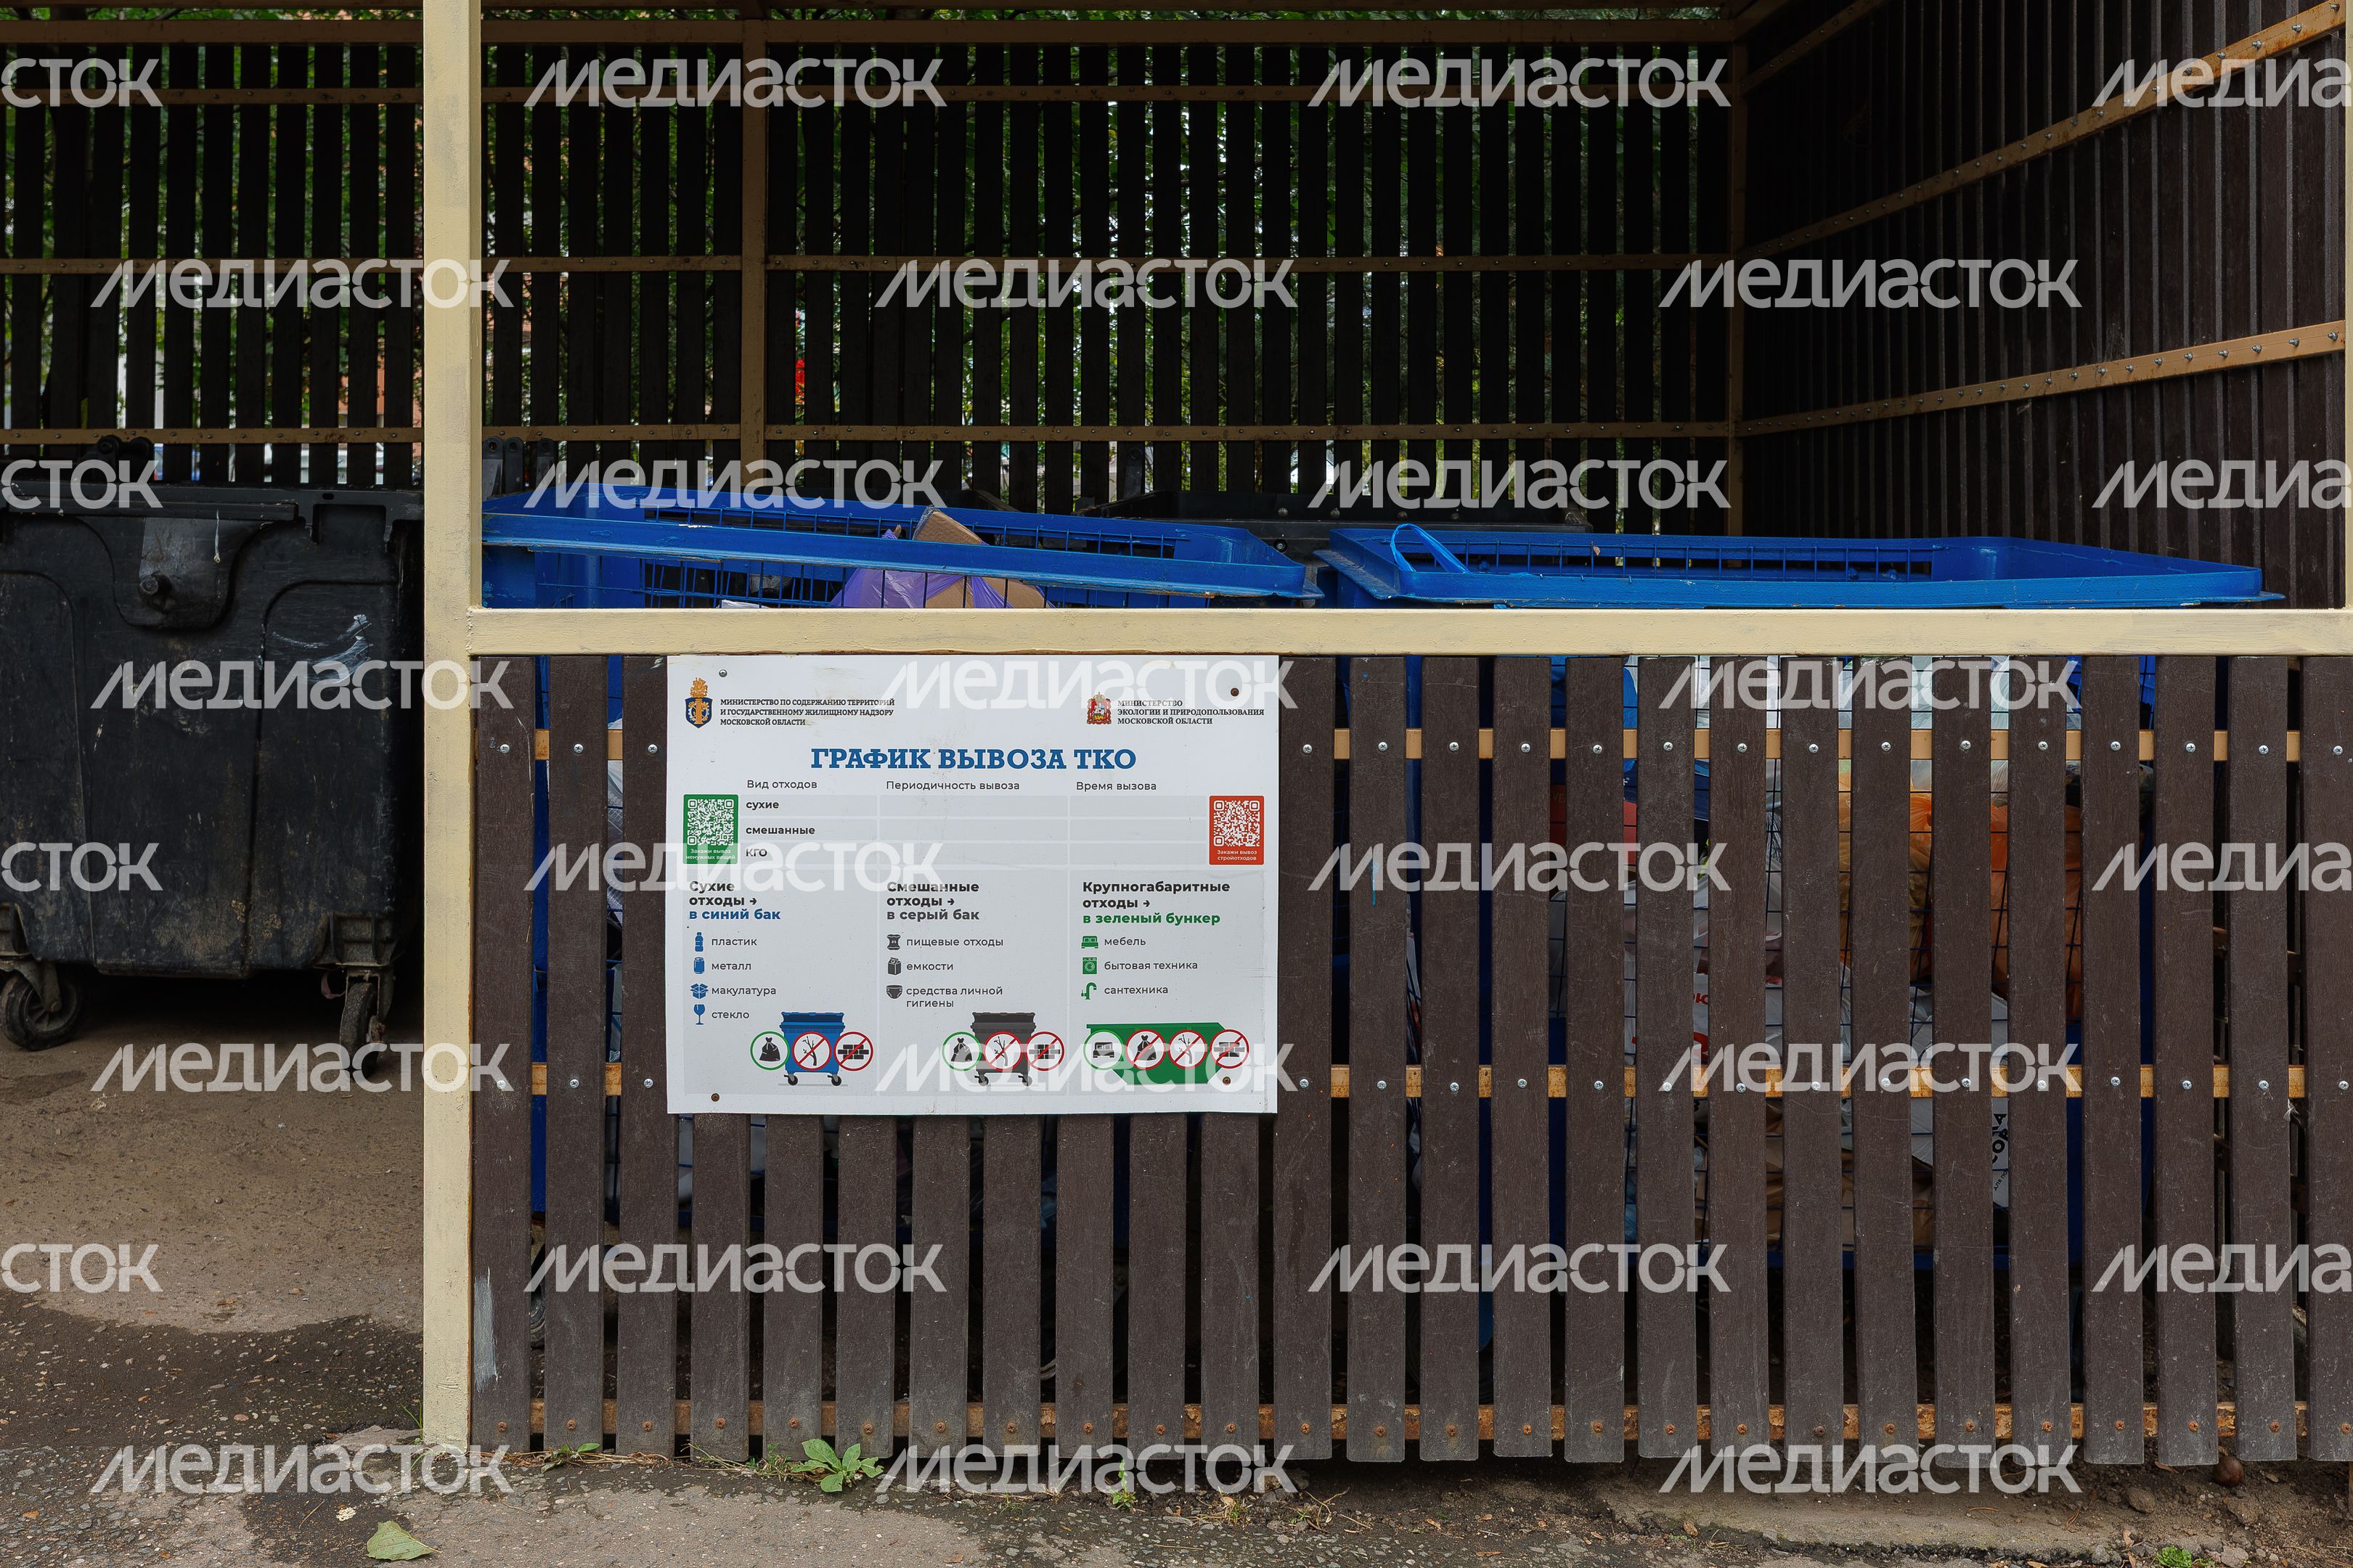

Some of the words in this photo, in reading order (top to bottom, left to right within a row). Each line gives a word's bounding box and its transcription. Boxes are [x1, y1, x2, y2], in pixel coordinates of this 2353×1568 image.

[811, 748, 931, 769] ГРАФИК
[938, 748, 1067, 769] ВЫВОЗА
[1073, 748, 1137, 770] ТКО
[747, 780, 769, 791] Вид
[772, 780, 817, 791] отходов
[886, 780, 976, 791] Периодичность
[979, 780, 1020, 791] вывоза
[1076, 781, 1113, 792] Время
[1117, 781, 1157, 791] вызова
[746, 801, 779, 811] сухие
[746, 848, 767, 857] КГО
[689, 881, 735, 894] Сухие
[886, 881, 979, 892] Смешанные
[1082, 881, 1230, 894] Крупногабаритные
[689, 896, 745, 907] отходы
[886, 897, 942, 907] отходы
[1082, 898, 1138, 910] отходы
[690, 910, 698, 920] в
[701, 908, 750, 920] синий
[754, 908, 781, 920] бак
[886, 911, 896, 920] в
[900, 908, 949, 923] серый
[953, 908, 980, 920] бак
[1082, 915, 1091, 924] в
[1095, 912, 1162, 924] зеленый
[1165, 912, 1220, 926] бункер
[711, 937, 757, 947] пластик
[906, 937, 960, 947] пищевые
[963, 937, 1004, 947] отходы
[1104, 937, 1146, 947] мебель
[711, 962, 751, 971] металл
[906, 962, 954, 971] емкости
[1104, 960, 1152, 971] бытовая
[1154, 961, 1198, 971] техника
[711, 986, 777, 997] макулатура
[906, 987, 958, 997] средства
[961, 985, 1004, 996] личной
[1104, 985, 1169, 995] сантехника
[906, 999, 955, 1008] гигиены
[711, 1010, 750, 1020] стекло
